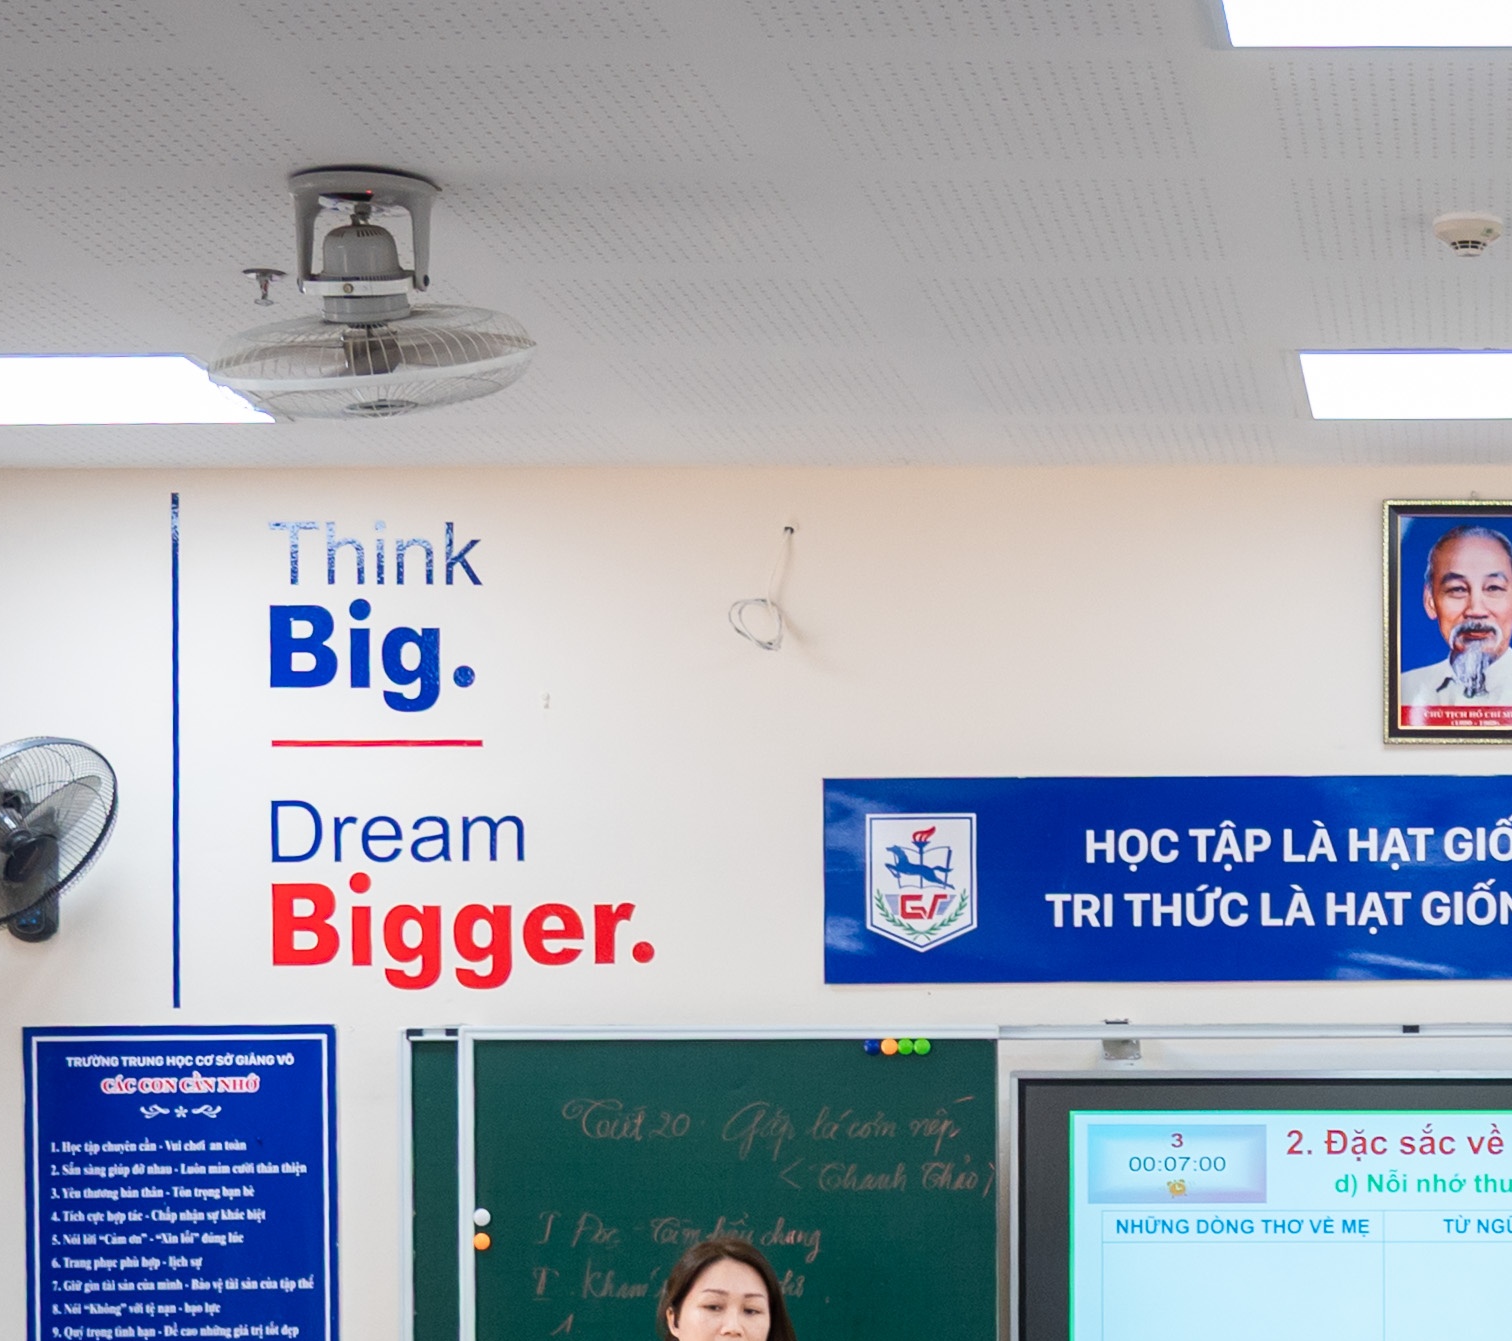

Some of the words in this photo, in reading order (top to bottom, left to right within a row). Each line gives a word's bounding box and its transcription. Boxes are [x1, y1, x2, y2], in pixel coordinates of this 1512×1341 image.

[272, 522, 483, 585] Think
[270, 599, 475, 712] Big.
[271, 800, 524, 862] Dream
[1086, 829, 1179, 872] HỌC
[1189, 820, 1271, 871] TẬP
[1284, 820, 1337, 862] LÀ
[1349, 828, 1434, 870] HẠT
[1045, 894, 1113, 927] TRI
[1124, 884, 1248, 927] THỨC
[1261, 884, 1315, 926] LÀ
[1326, 892, 1412, 934] HẠT
[272, 872, 654, 990] Bigger.
[66, 1055, 119, 1067] TRƯỜNG
[121, 1056, 164, 1066] TRUNG
[166, 1056, 193, 1068] HỌC
[195, 1055, 214, 1066] CƠ
[216, 1053, 234, 1066] SỞ
[235, 1053, 275, 1065] GIẢNG
[277, 1053, 294, 1065] VÕ
[101, 1073, 137, 1094] CÁC
[138, 1077, 178, 1094] CON
[217, 1073, 261, 1093] NHỚ
[1172, 1133, 1183, 1148] 3
[1288, 1130, 1311, 1154] 2.
[1325, 1130, 1387, 1161] Đặc
[1400, 1124, 1455, 1154] sắc
[1467, 1124, 1503, 1154] về
[1129, 1157, 1225, 1171] 00:07:00
[1335, 1174, 1357, 1197] d)
[1368, 1170, 1407, 1192] Nỗi
[1417, 1174, 1466, 1193] nhớ
[1117, 1217, 1189, 1234] NHỮNG
[1197, 1216, 1254, 1234] DÒNG
[1261, 1219, 1304, 1234] THƠ
[1342, 1219, 1369, 1236] MẸ
[1443, 1216, 1470, 1233] TỪ
